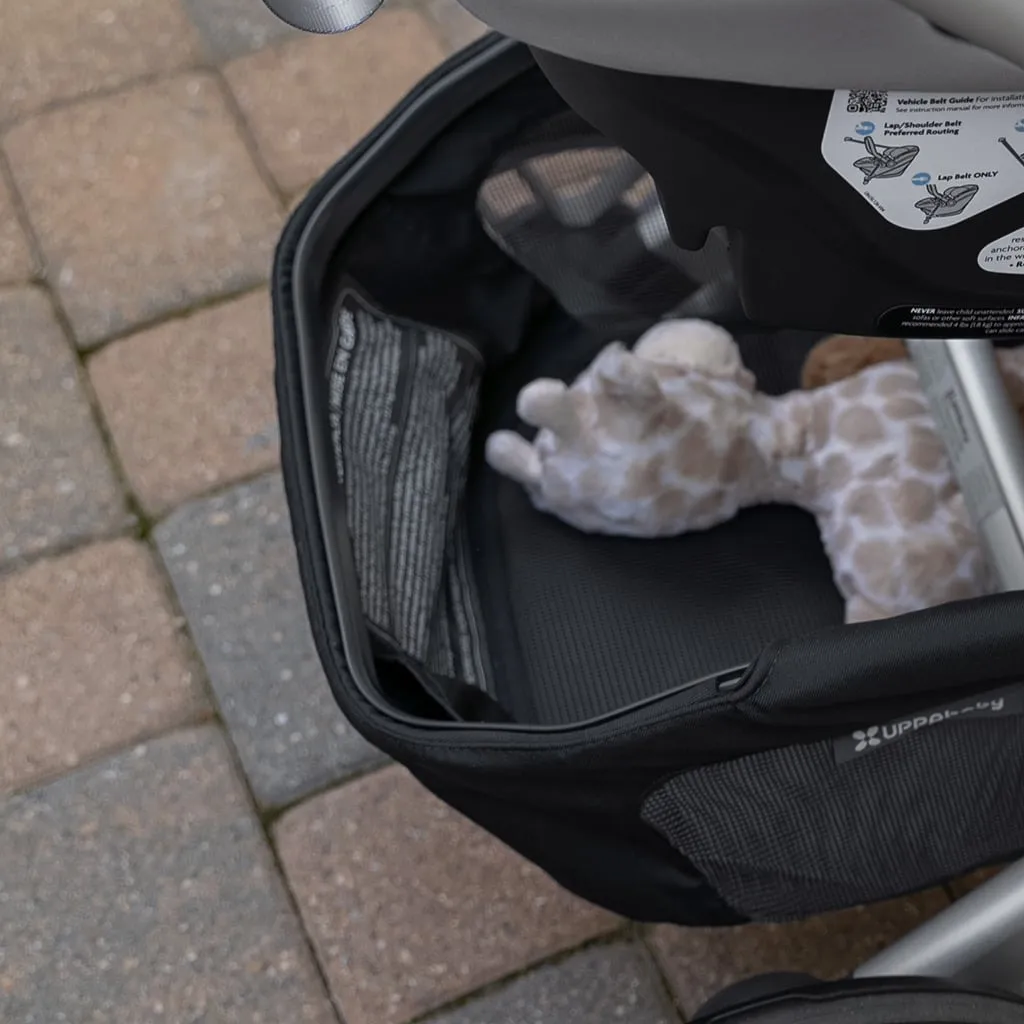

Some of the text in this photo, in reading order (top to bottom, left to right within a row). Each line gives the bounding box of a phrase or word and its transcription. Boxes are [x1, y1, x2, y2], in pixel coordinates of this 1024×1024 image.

[898, 98, 928, 106] Vehicle
[883, 121, 942, 129] Lap/Shoulder
[883, 128, 959, 136] Preferred Routing
[937, 171, 998, 182] Lap Belt ONLY
[996, 252, 1012, 261] the
[882, 697, 1004, 740] UPPAy
